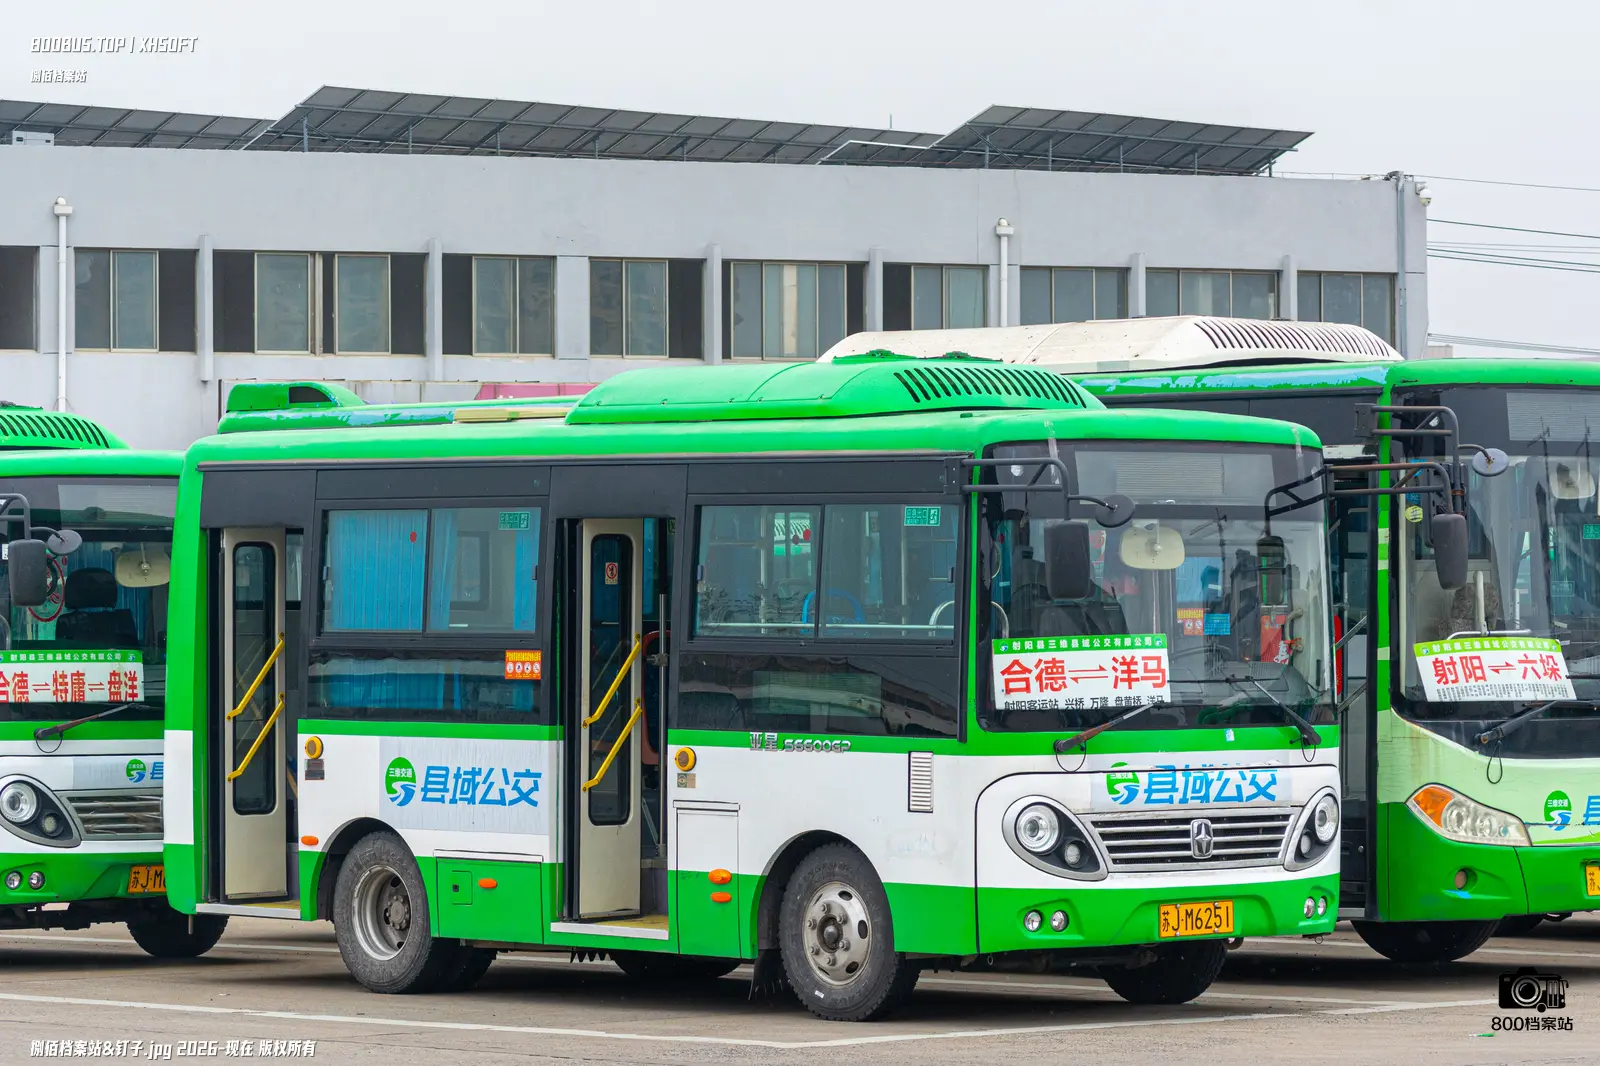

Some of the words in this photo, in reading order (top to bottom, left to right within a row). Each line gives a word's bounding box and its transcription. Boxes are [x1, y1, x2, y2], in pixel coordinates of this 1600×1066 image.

[999, 657, 1067, 695] 合德
[1111, 655, 1167, 690] 洋马
[1432, 655, 1487, 686] 射阳
[1517, 653, 1562, 682] 六垛
[1004, 699, 1059, 711] 射阳客运站
[1064, 697, 1085, 709] 兴桥
[749, 731, 778, 752] 亚星
[420, 765, 543, 807] 县域公交
[1143, 762, 1278, 804] 县域公交
